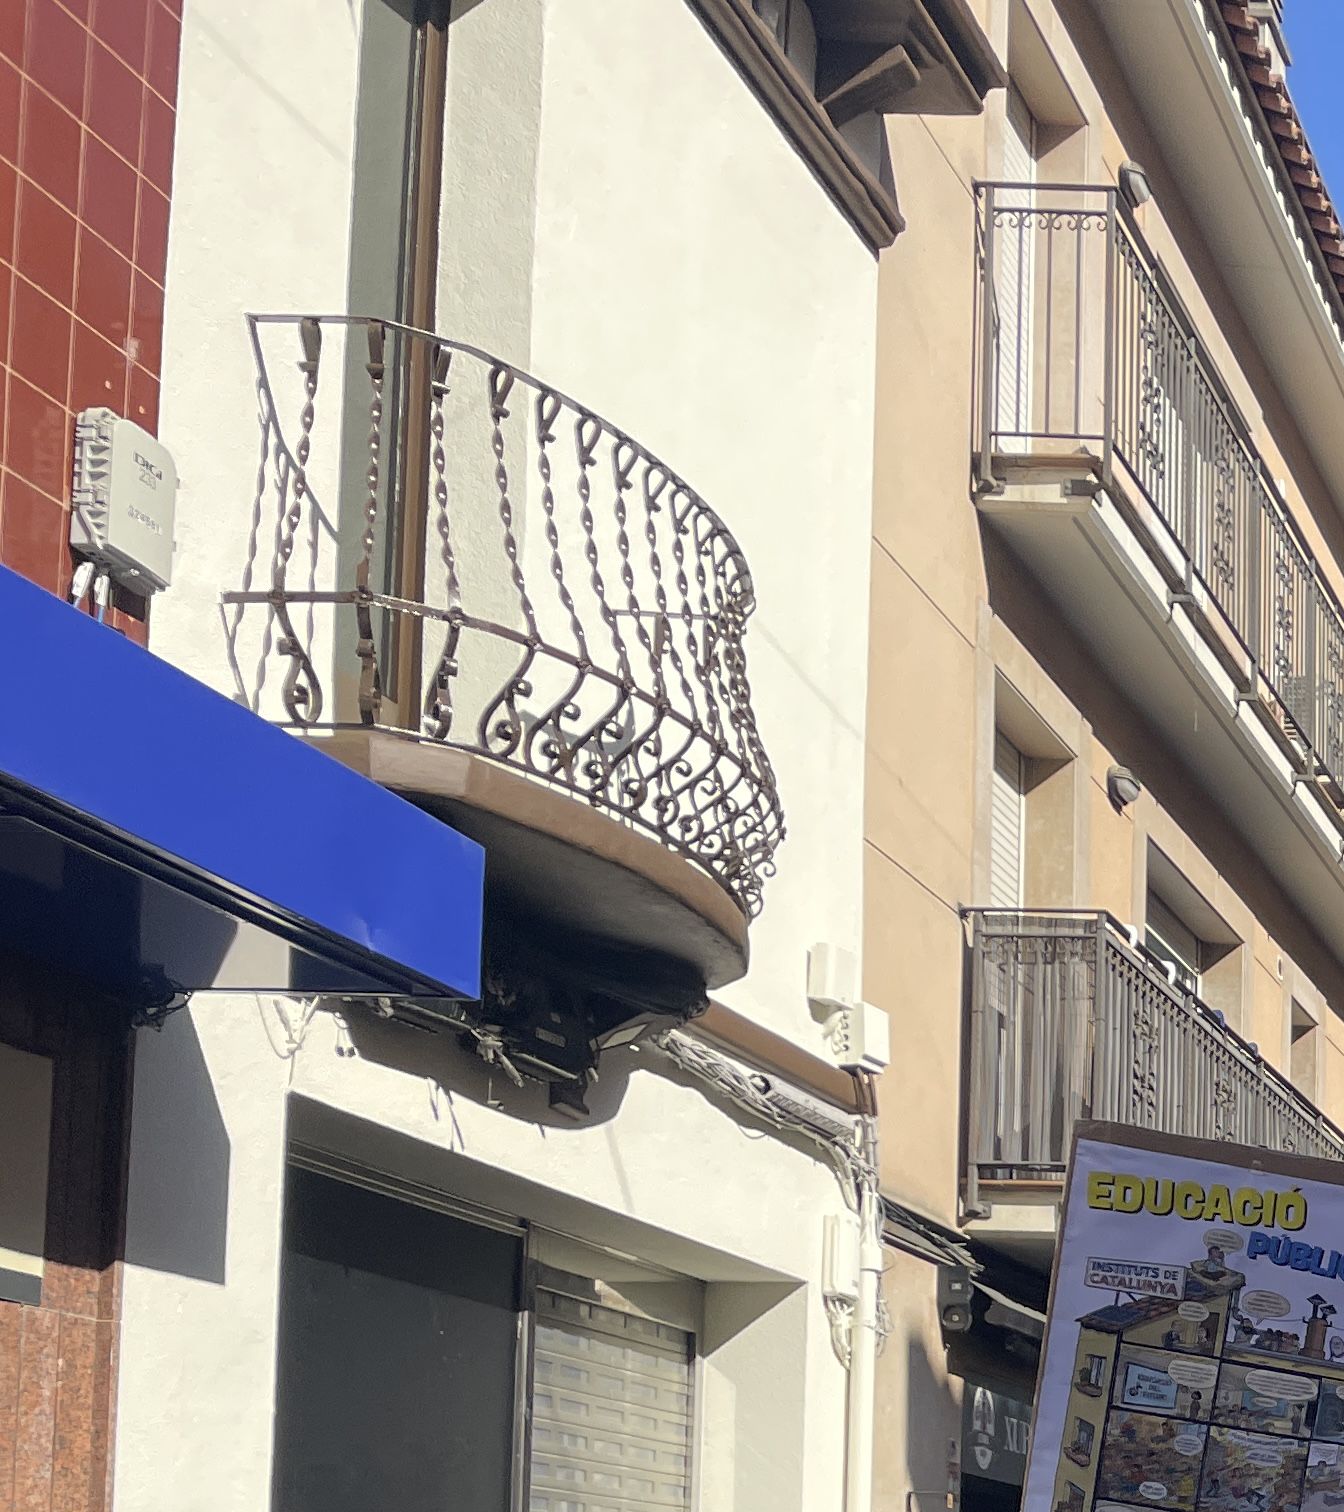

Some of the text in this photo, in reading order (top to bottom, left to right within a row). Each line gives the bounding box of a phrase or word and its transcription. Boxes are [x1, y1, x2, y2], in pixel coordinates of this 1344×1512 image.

[1087, 1171, 1308, 1231] EDUCACIÓ
[1091, 1260, 1178, 1281] INSTITUTS DE
[1089, 1272, 1178, 1297] CATALUNYA
